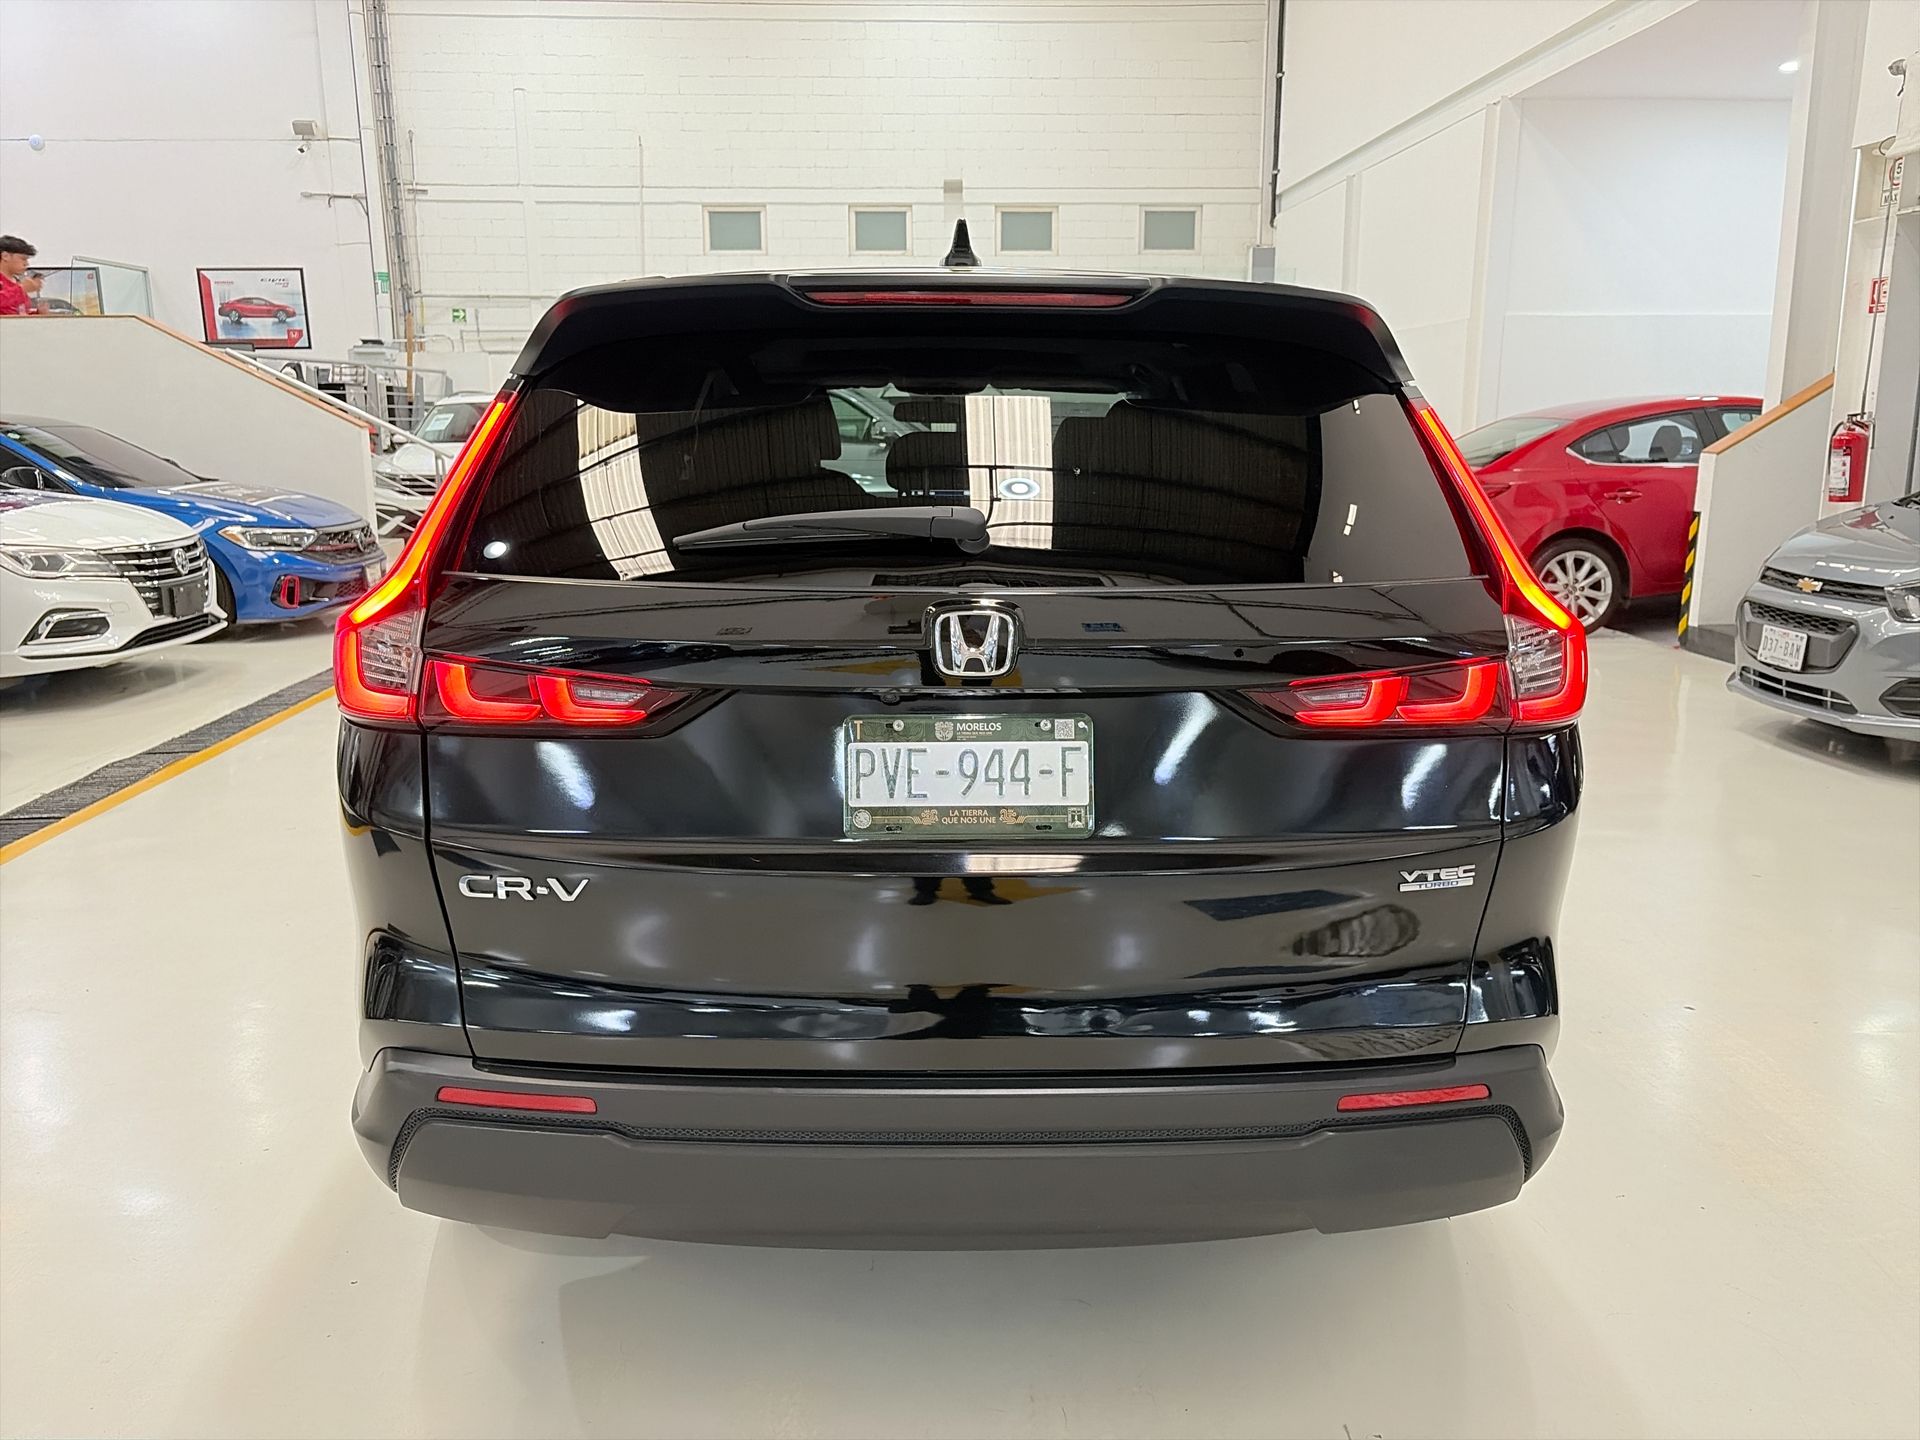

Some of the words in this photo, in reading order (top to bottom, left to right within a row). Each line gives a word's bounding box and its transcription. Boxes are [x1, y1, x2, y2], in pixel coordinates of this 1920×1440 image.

[956, 722, 1002, 731] MORELOS
[855, 746, 1082, 799] PVE-944-F
[949, 809, 959, 817] LA
[961, 809, 989, 817] TIERRA
[941, 817, 959, 825] QUE
[1400, 864, 1476, 882] VTEC
[458, 874, 590, 902] CR-V
[1418, 880, 1459, 889] TURBO
